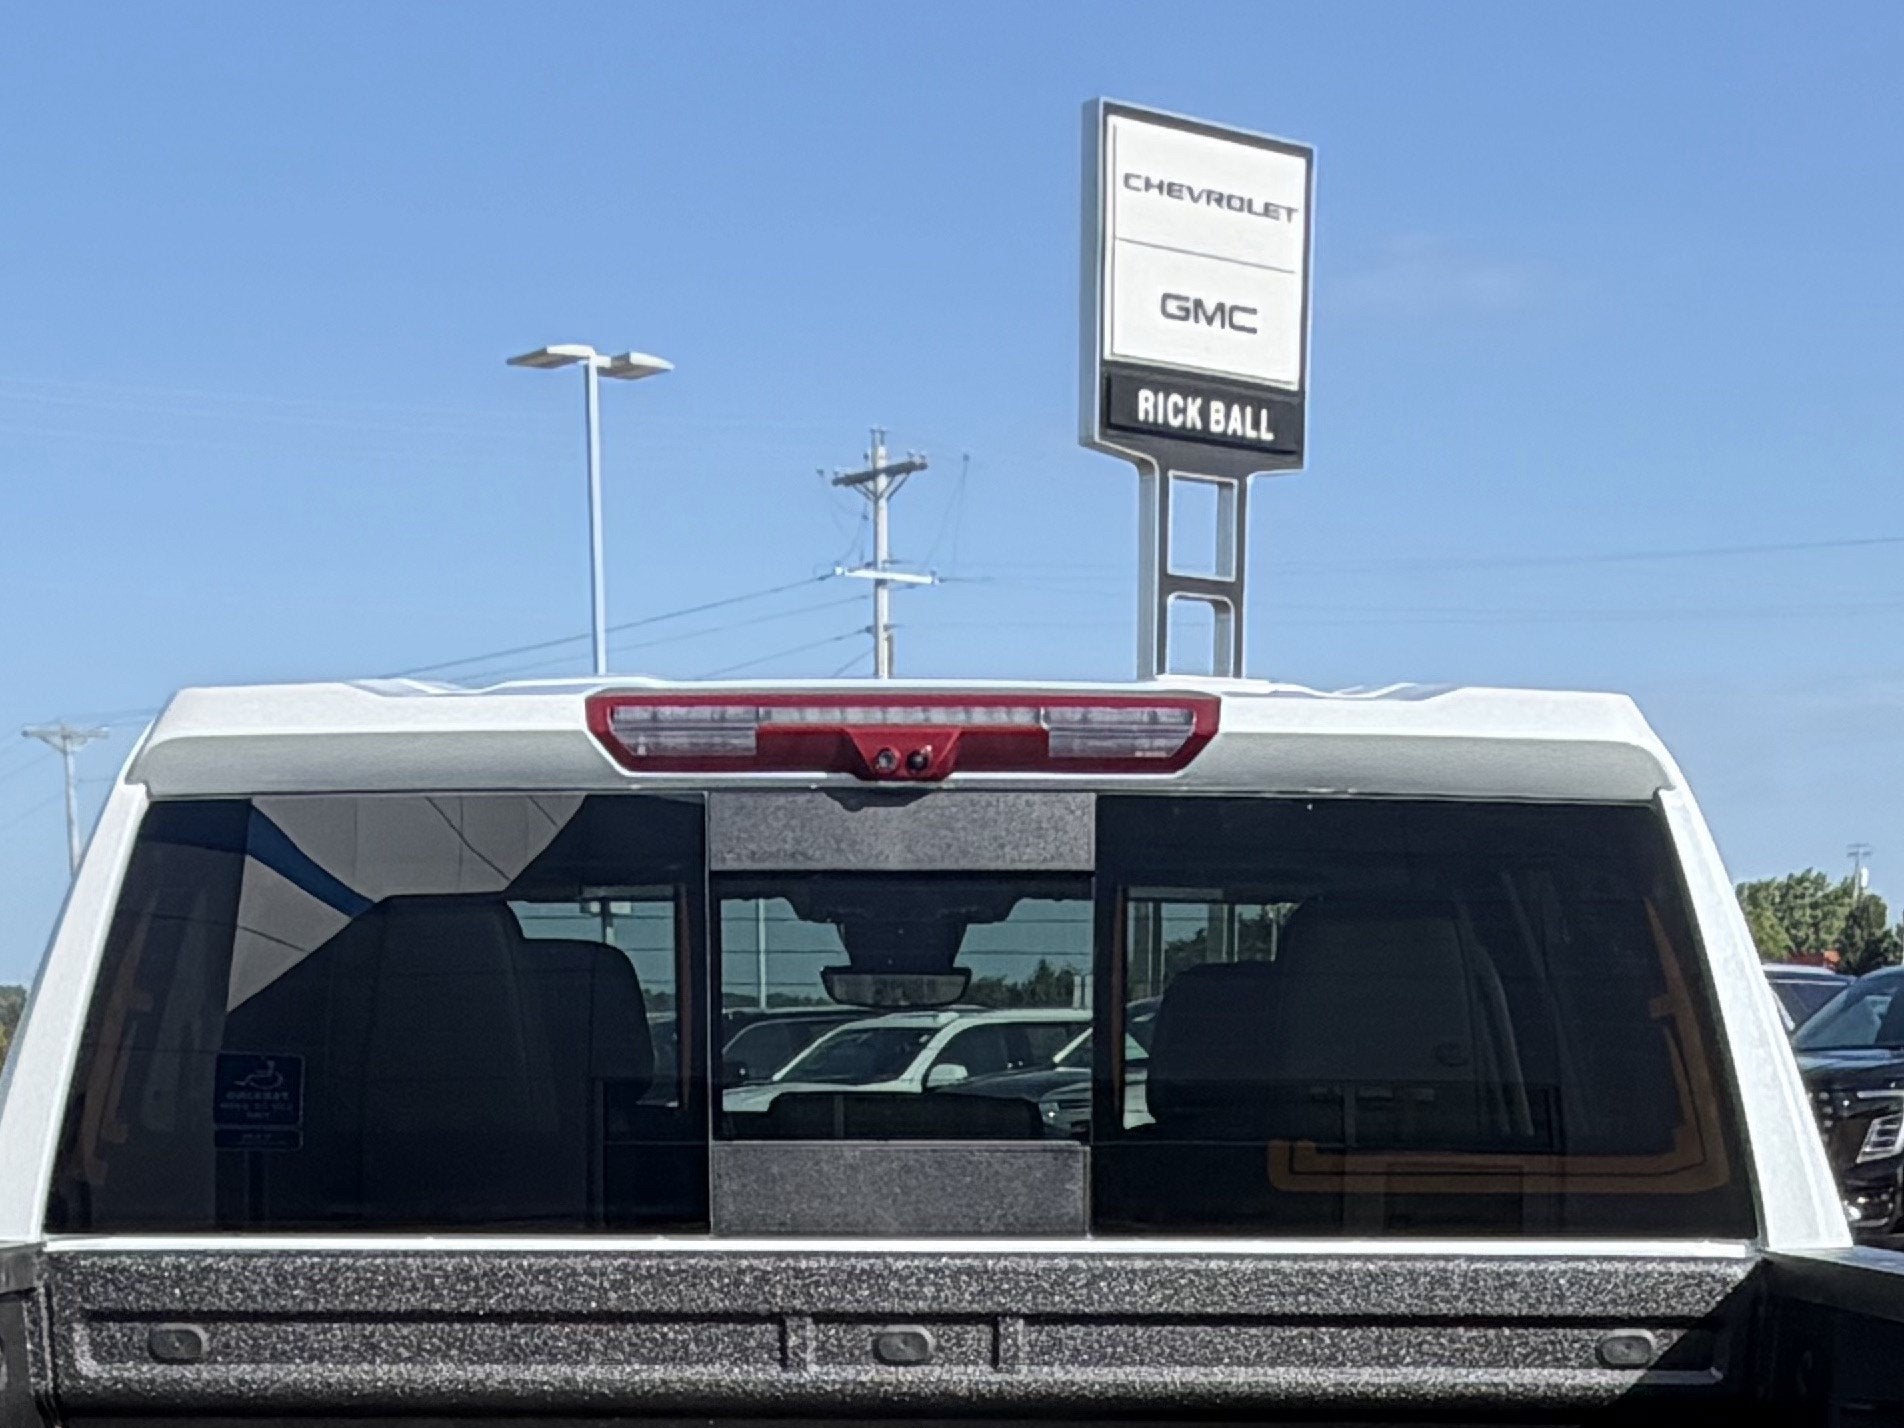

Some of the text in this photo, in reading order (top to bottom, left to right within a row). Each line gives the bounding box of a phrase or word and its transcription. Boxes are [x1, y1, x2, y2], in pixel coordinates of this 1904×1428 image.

[1122, 171, 1299, 224] CHEVROLET
[1159, 292, 1259, 335] GMC
[1136, 387, 1276, 442] RICK BALL
